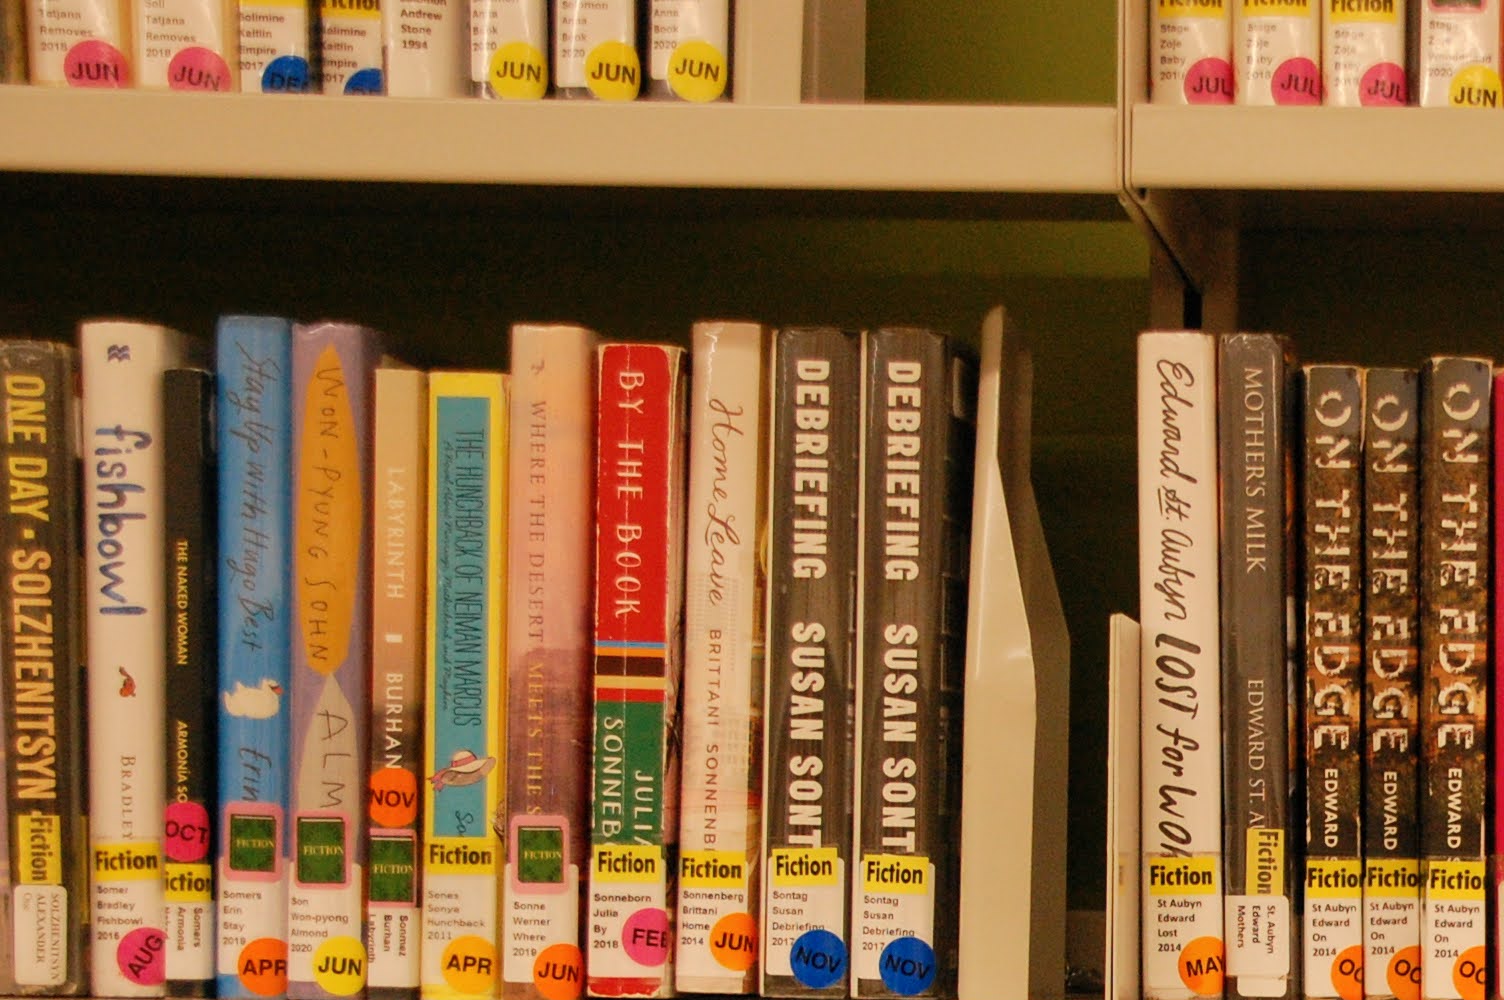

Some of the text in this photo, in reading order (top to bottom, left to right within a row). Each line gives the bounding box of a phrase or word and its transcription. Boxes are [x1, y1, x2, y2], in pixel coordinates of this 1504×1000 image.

[401, 10, 442, 21] Andrew
[401, 25, 431, 35] Stone
[403, 41, 428, 49] 1994
[497, 61, 541, 82] JUN
[675, 59, 719, 81] JUN
[1455, 87, 1496, 107] JUN
[1156, 359, 1197, 484] Edward
[1244, 367, 1266, 574] MOTHER'S MILK
[226, 342, 280, 650] Stay Up with Hugo Best
[615, 371, 645, 618] BY THE BOOK
[702, 398, 744, 605] Home Leave
[95, 424, 152, 616] fishbowl
[790, 360, 829, 740] DEBRIEFING SUSAN
[453, 430, 485, 726] THE HUNCHBACK OF NEIMAN MARCUS
[1154, 522, 1196, 621] Aubyn
[1314, 391, 1351, 749] ON THE EDGE
[5, 375, 57, 801] ONE DAY SOLZHENITSYN
[178, 541, 189, 666] THE NAKED WOMAN
[525, 402, 547, 804] WHERE THE DESERT MEETS THE
[305, 579, 337, 661] SOHN
[385, 467, 406, 769] LABYRINTH BURHAN
[707, 629, 722, 729] BRITTANI
[1158, 723, 1200, 778] for
[121, 754, 136, 840] BRADLEY
[370, 789, 414, 808] NOV
[29, 816, 53, 882] Fiction
[430, 845, 492, 864] Fiction
[96, 850, 158, 871] Fiction
[1150, 866, 1213, 886] Fiction
[223, 890, 261, 900] Somers
[594, 894, 651, 902] Sonneborn
[683, 891, 744, 902] Sonnenberg
[291, 913, 349, 925] Won-pyong
[1312, 904, 1357, 914] St Aubyn
[291, 928, 328, 938] Almond
[428, 919, 485, 928] Hunchback
[1312, 918, 1350, 927] Edward
[1158, 929, 1178, 938] Lost
[1158, 943, 1181, 952] 2014
[318, 957, 362, 977] JUN
[446, 956, 491, 974] APR
